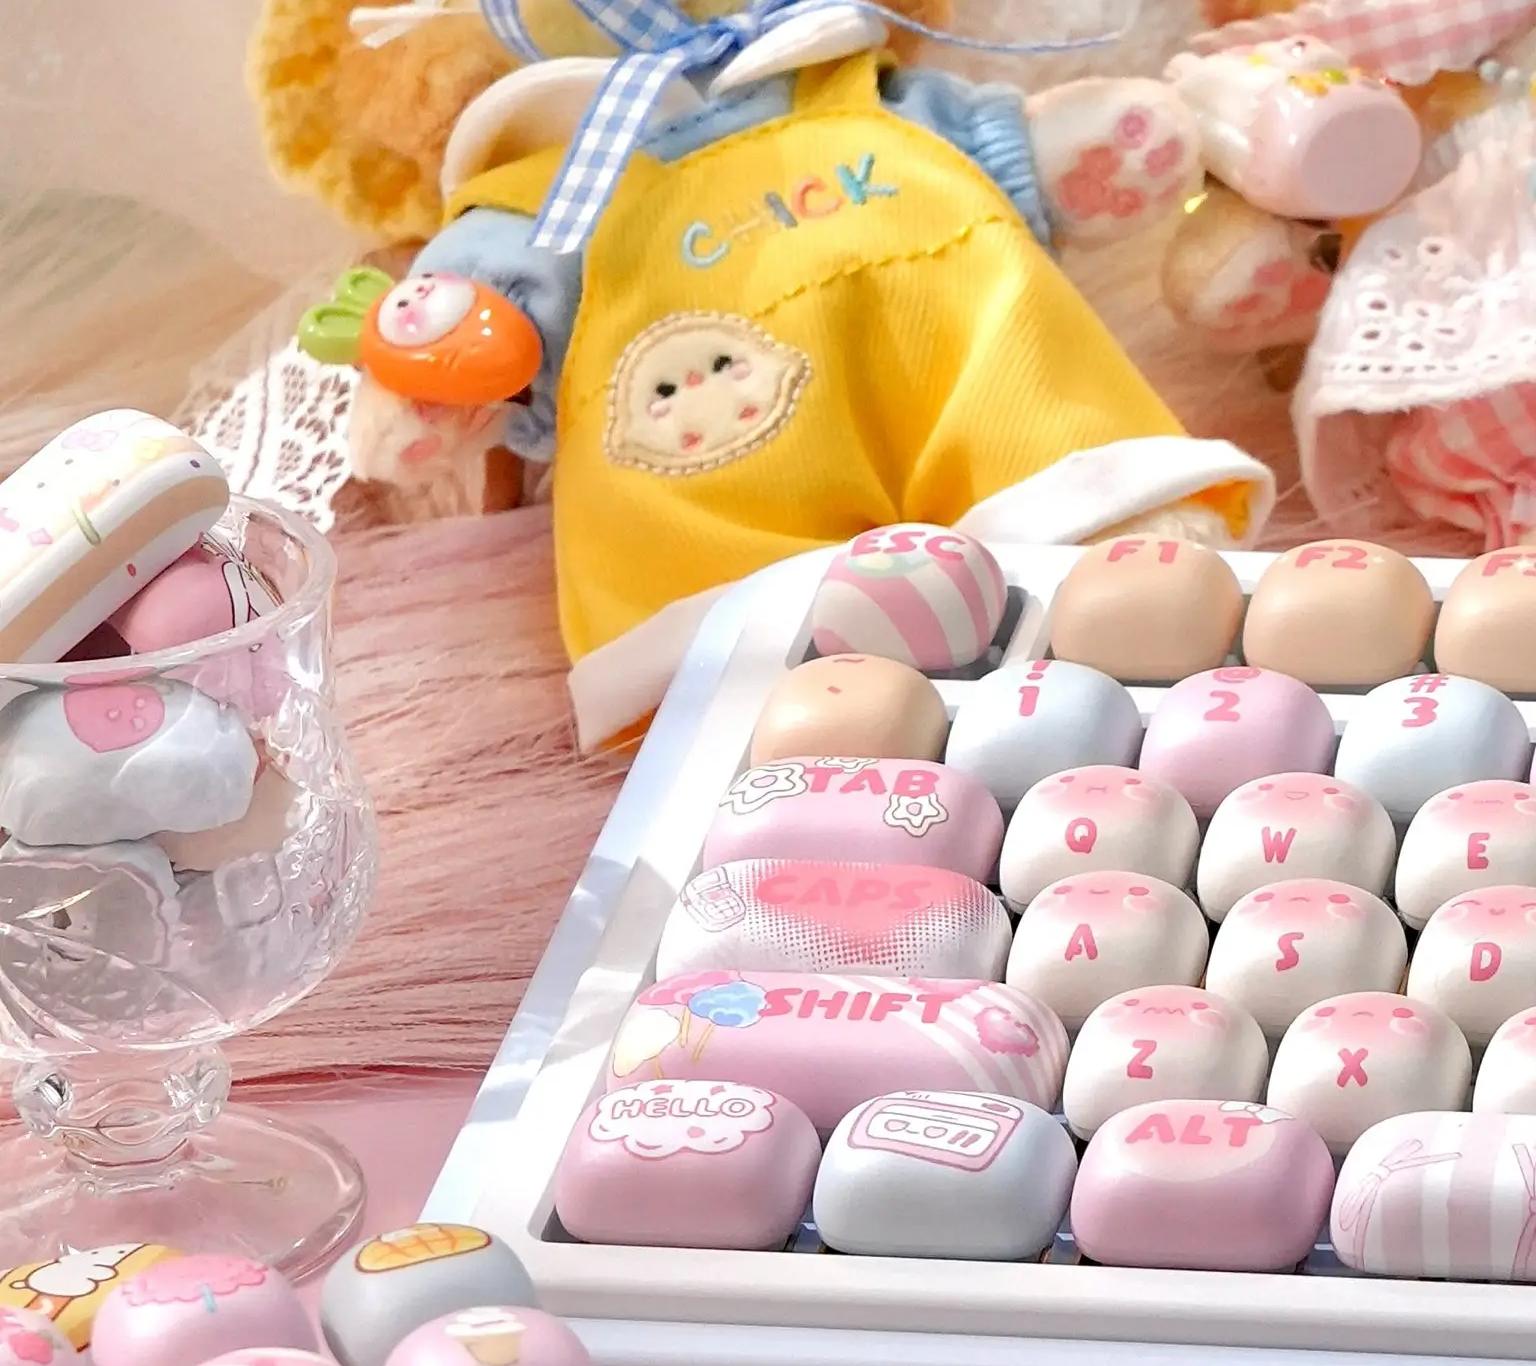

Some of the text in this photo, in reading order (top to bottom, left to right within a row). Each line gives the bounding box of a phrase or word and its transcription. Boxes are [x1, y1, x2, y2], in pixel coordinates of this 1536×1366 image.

[850, 531, 967, 562] ESC
[1106, 540, 1180, 565] F1
[1295, 546, 1369, 570] F2
[1213, 666, 1262, 683] @
[1409, 674, 1449, 693] #
[1018, 685, 1040, 717] 1
[1203, 690, 1241, 722] 2
[1402, 697, 1438, 728] 3
[804, 766, 940, 798] TAB
[1065, 817, 1097, 853] Q
[1261, 826, 1298, 863] W
[1466, 833, 1491, 870] E
[755, 875, 933, 910] CAPS
[1065, 923, 1099, 961] A
[1276, 932, 1305, 972] S
[1469, 942, 1502, 982] D
[757, 987, 960, 1024] SHIFT
[1126, 1039, 1158, 1079] Z
[1336, 1048, 1369, 1088] X
[611, 1095, 756, 1120] HELLO
[1124, 1113, 1261, 1149] ALT
